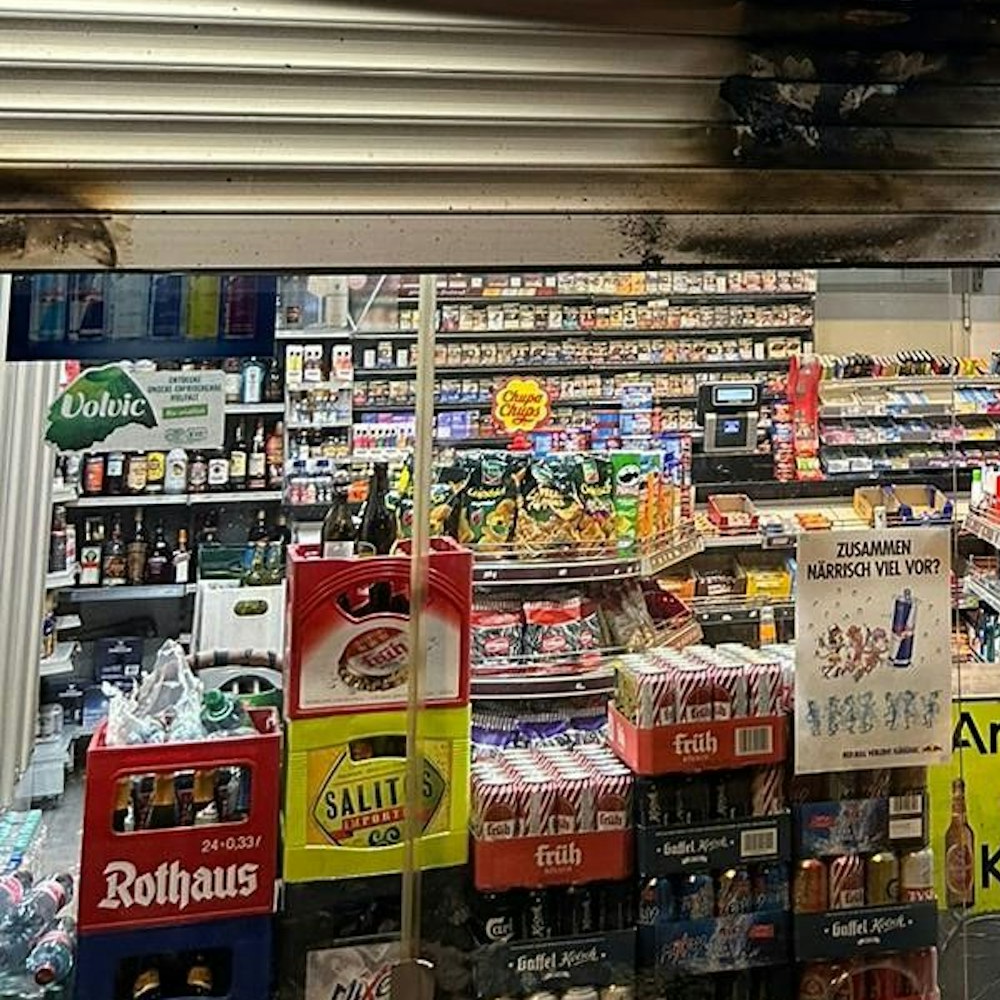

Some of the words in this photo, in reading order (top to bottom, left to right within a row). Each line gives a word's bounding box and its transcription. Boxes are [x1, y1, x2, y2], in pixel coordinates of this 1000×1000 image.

[60, 391, 147, 419] Volvic
[503, 390, 544, 407] Chupa
[500, 403, 541, 425] Chups
[837, 540, 911, 558] ZUSAMMEN
[807, 560, 871, 580] NÄRRISCH
[876, 561, 901, 577] VIEL
[905, 558, 941, 575] VOR?
[673, 729, 719, 756] früh
[325, 771, 432, 819] SALITS
[534, 842, 583, 868] früh
[97, 859, 260, 911] Rothaus
[832, 921, 868, 937] Gaffel
[516, 951, 557, 971] Gaffel
